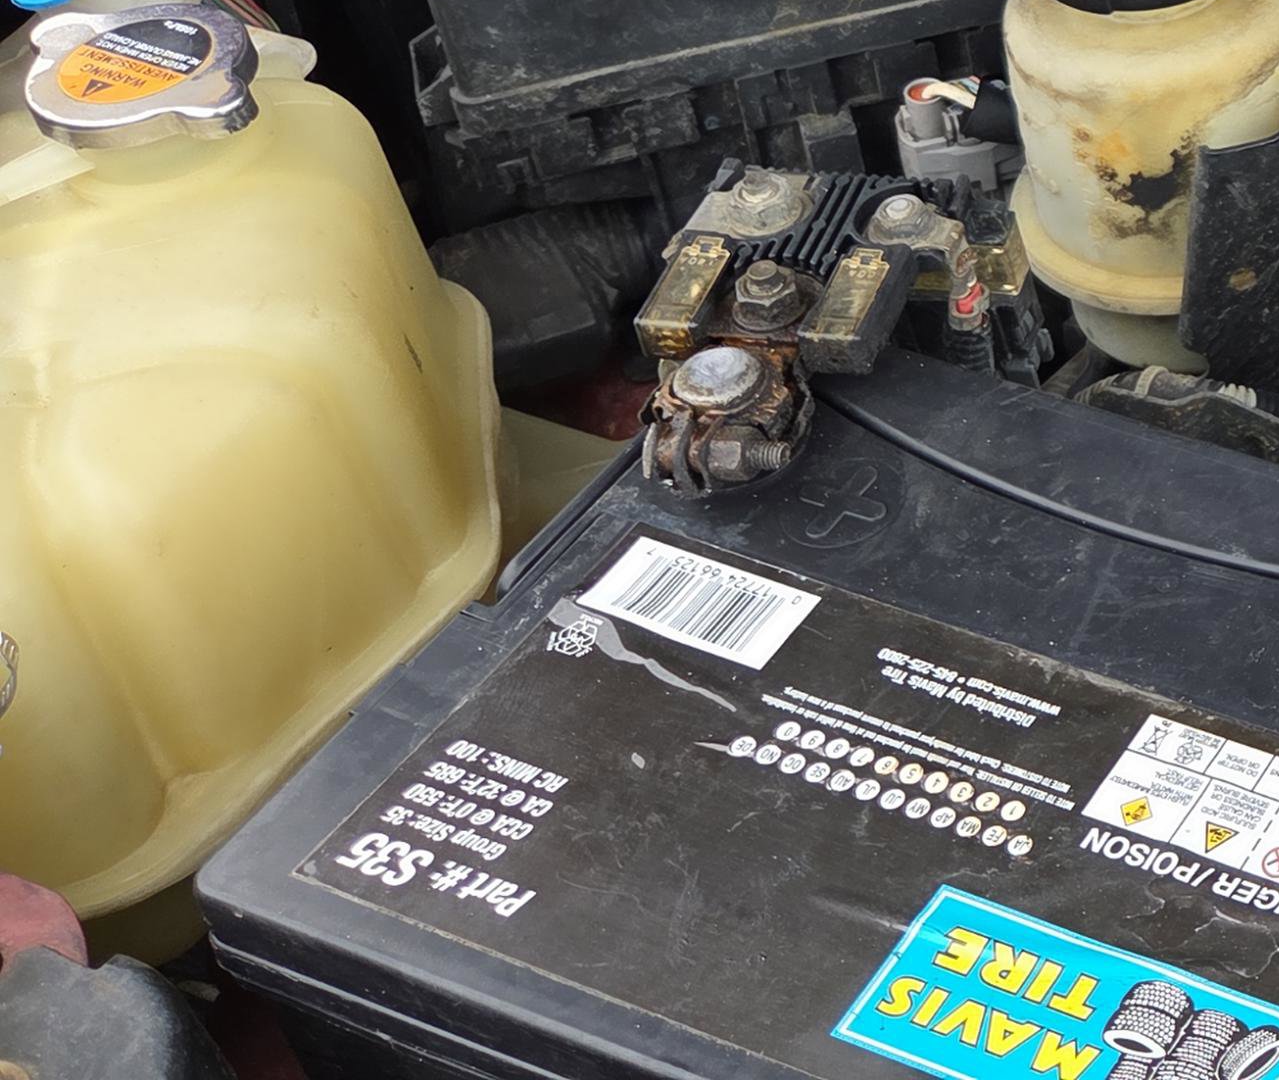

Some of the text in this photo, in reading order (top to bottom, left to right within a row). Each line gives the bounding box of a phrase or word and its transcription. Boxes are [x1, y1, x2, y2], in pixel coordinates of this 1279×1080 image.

[77, 47, 178, 82] AVERTISSEMENT
[78, 62, 146, 89] WARNING
[672, 554, 721, 580] 66125
[725, 573, 772, 599] 17724
[791, 594, 802, 605] 0
[880, 664, 1036, 728] Distributed by Mavis Tire
[966, 676, 1061, 715] www.mavis.com
[444, 738, 485, 762] 100
[423, 759, 465, 783] 685
[534, 770, 568, 793] RC
[401, 780, 444, 806] 550
[501, 787, 525, 806] @
[520, 793, 553, 817] CA
[471, 805, 495, 825] @
[488, 811, 533, 841] CCA
[379, 803, 506, 861] Group Size: 35
[1079, 825, 1215, 885] /POISON
[335, 828, 536, 916] Part #: S35
[931, 924, 1099, 1023] TIRE
[873, 970, 1101, 1080] MAVIS
